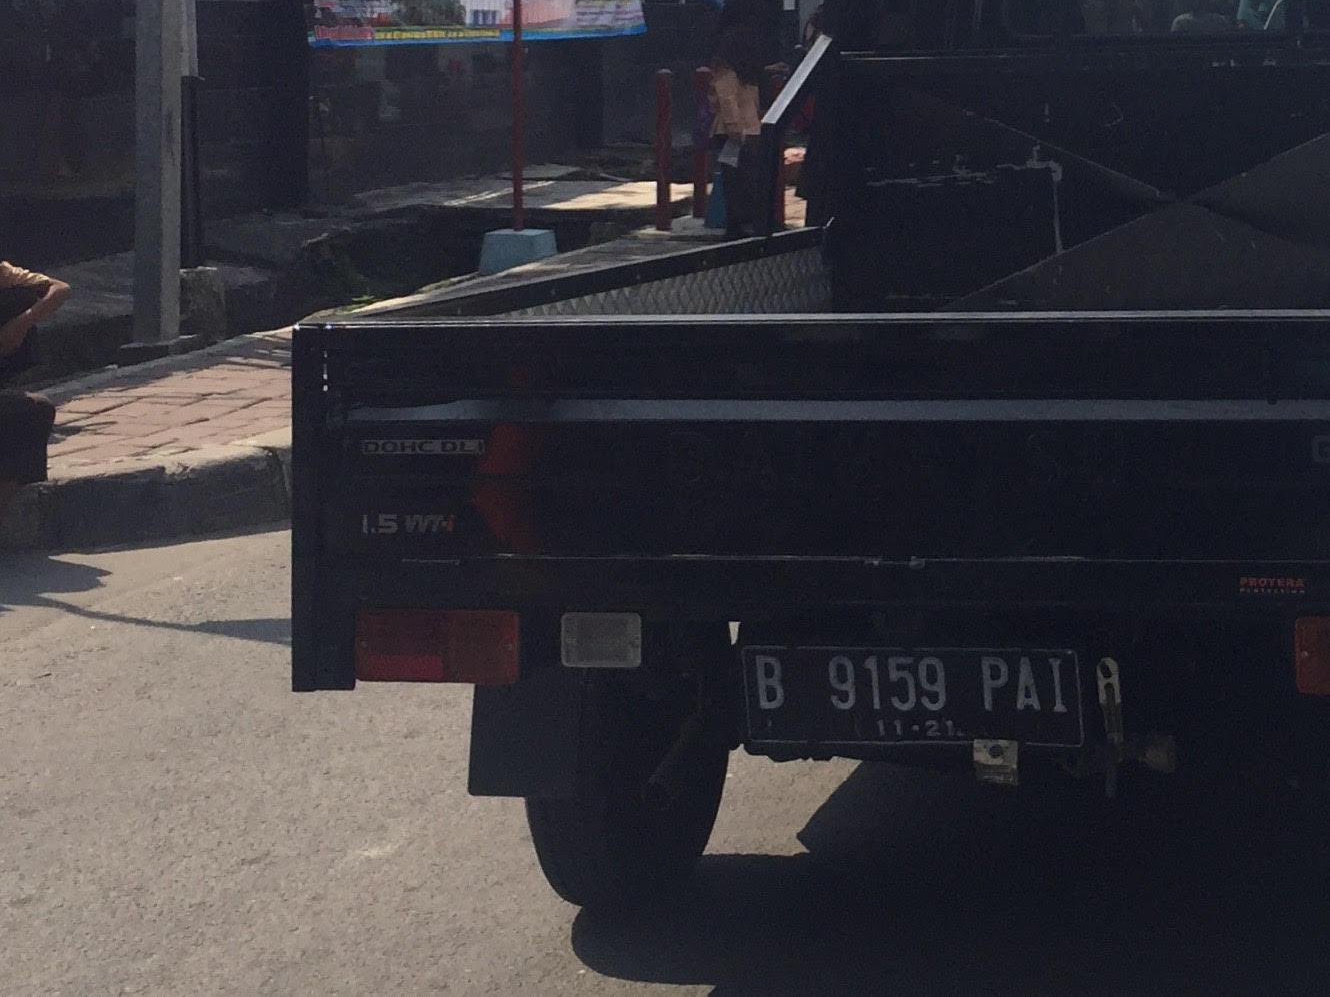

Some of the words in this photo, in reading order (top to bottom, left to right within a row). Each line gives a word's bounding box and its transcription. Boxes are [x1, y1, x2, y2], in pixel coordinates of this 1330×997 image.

[363, 440, 438, 452] DOHC
[361, 514, 399, 535] 1.5
[755, 655, 784, 709] B
[828, 655, 948, 711] 9159
[980, 657, 1068, 713] PAI
